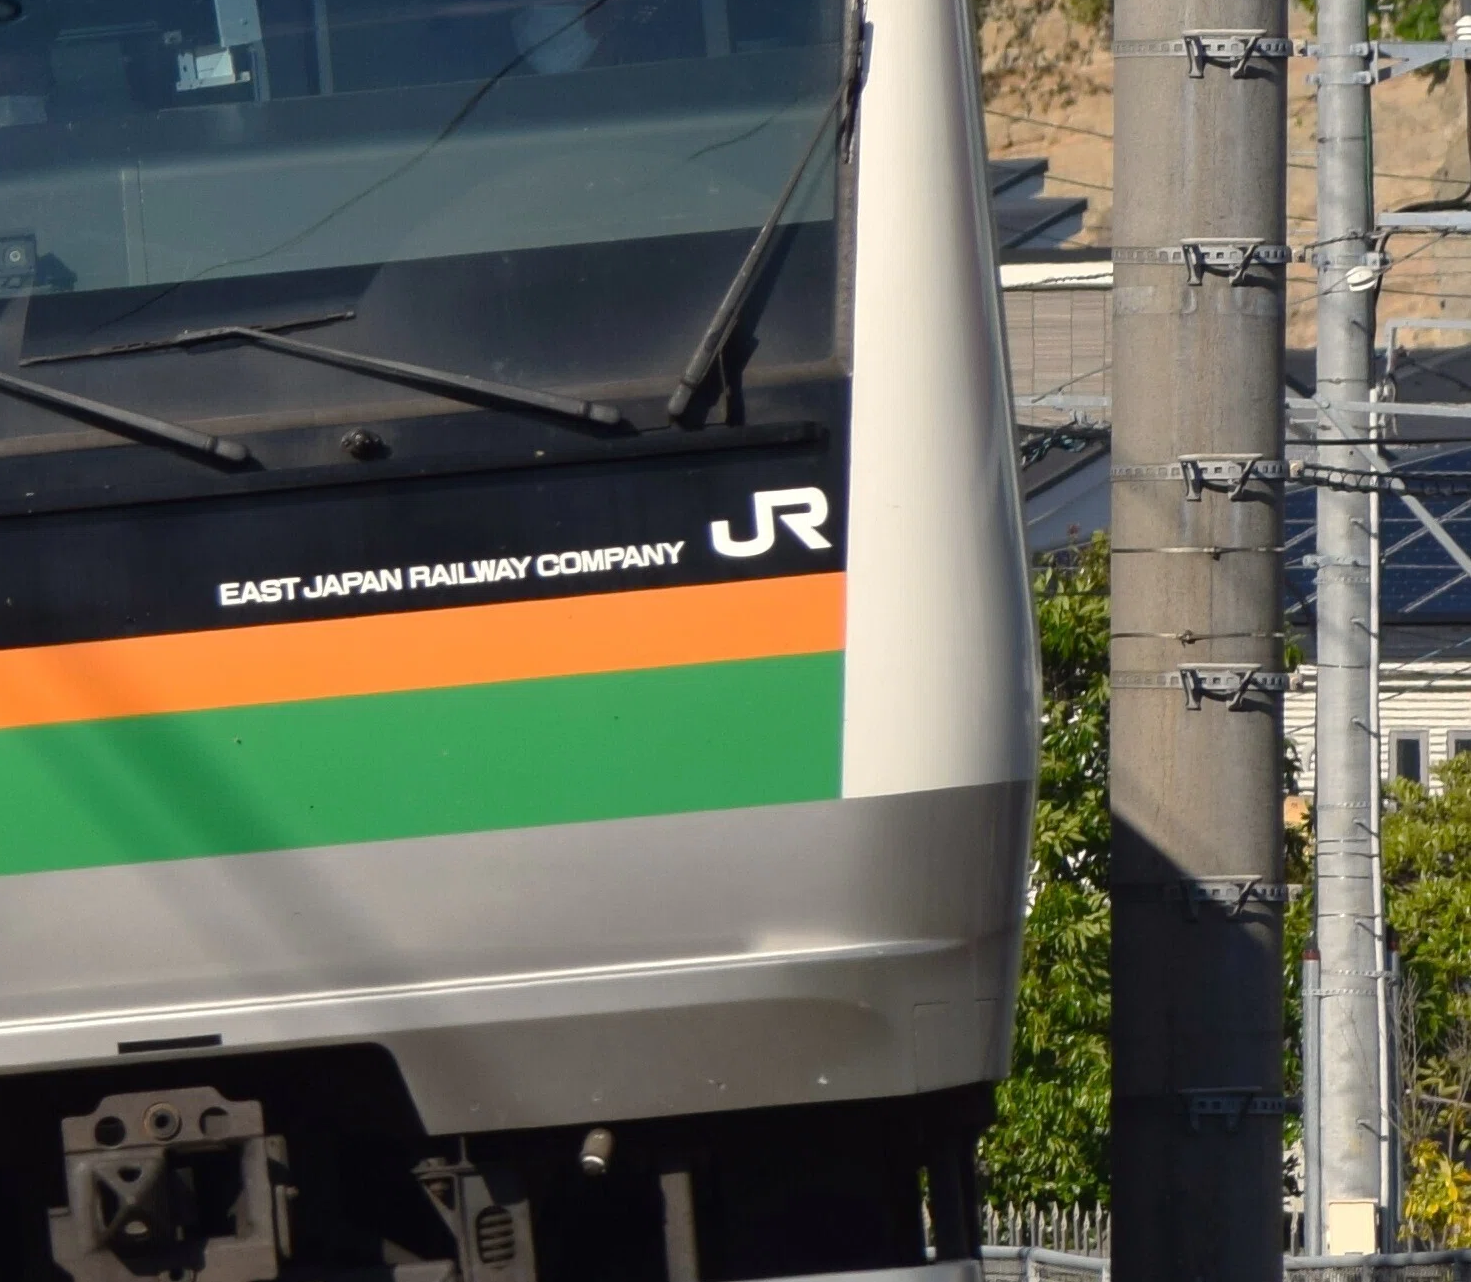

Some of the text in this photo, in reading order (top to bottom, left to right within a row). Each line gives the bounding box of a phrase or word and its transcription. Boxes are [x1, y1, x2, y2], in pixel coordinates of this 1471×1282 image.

[710, 486, 832, 557] JR
[219, 540, 686, 606] EAST JAPAN RAILWAY COMPANY
